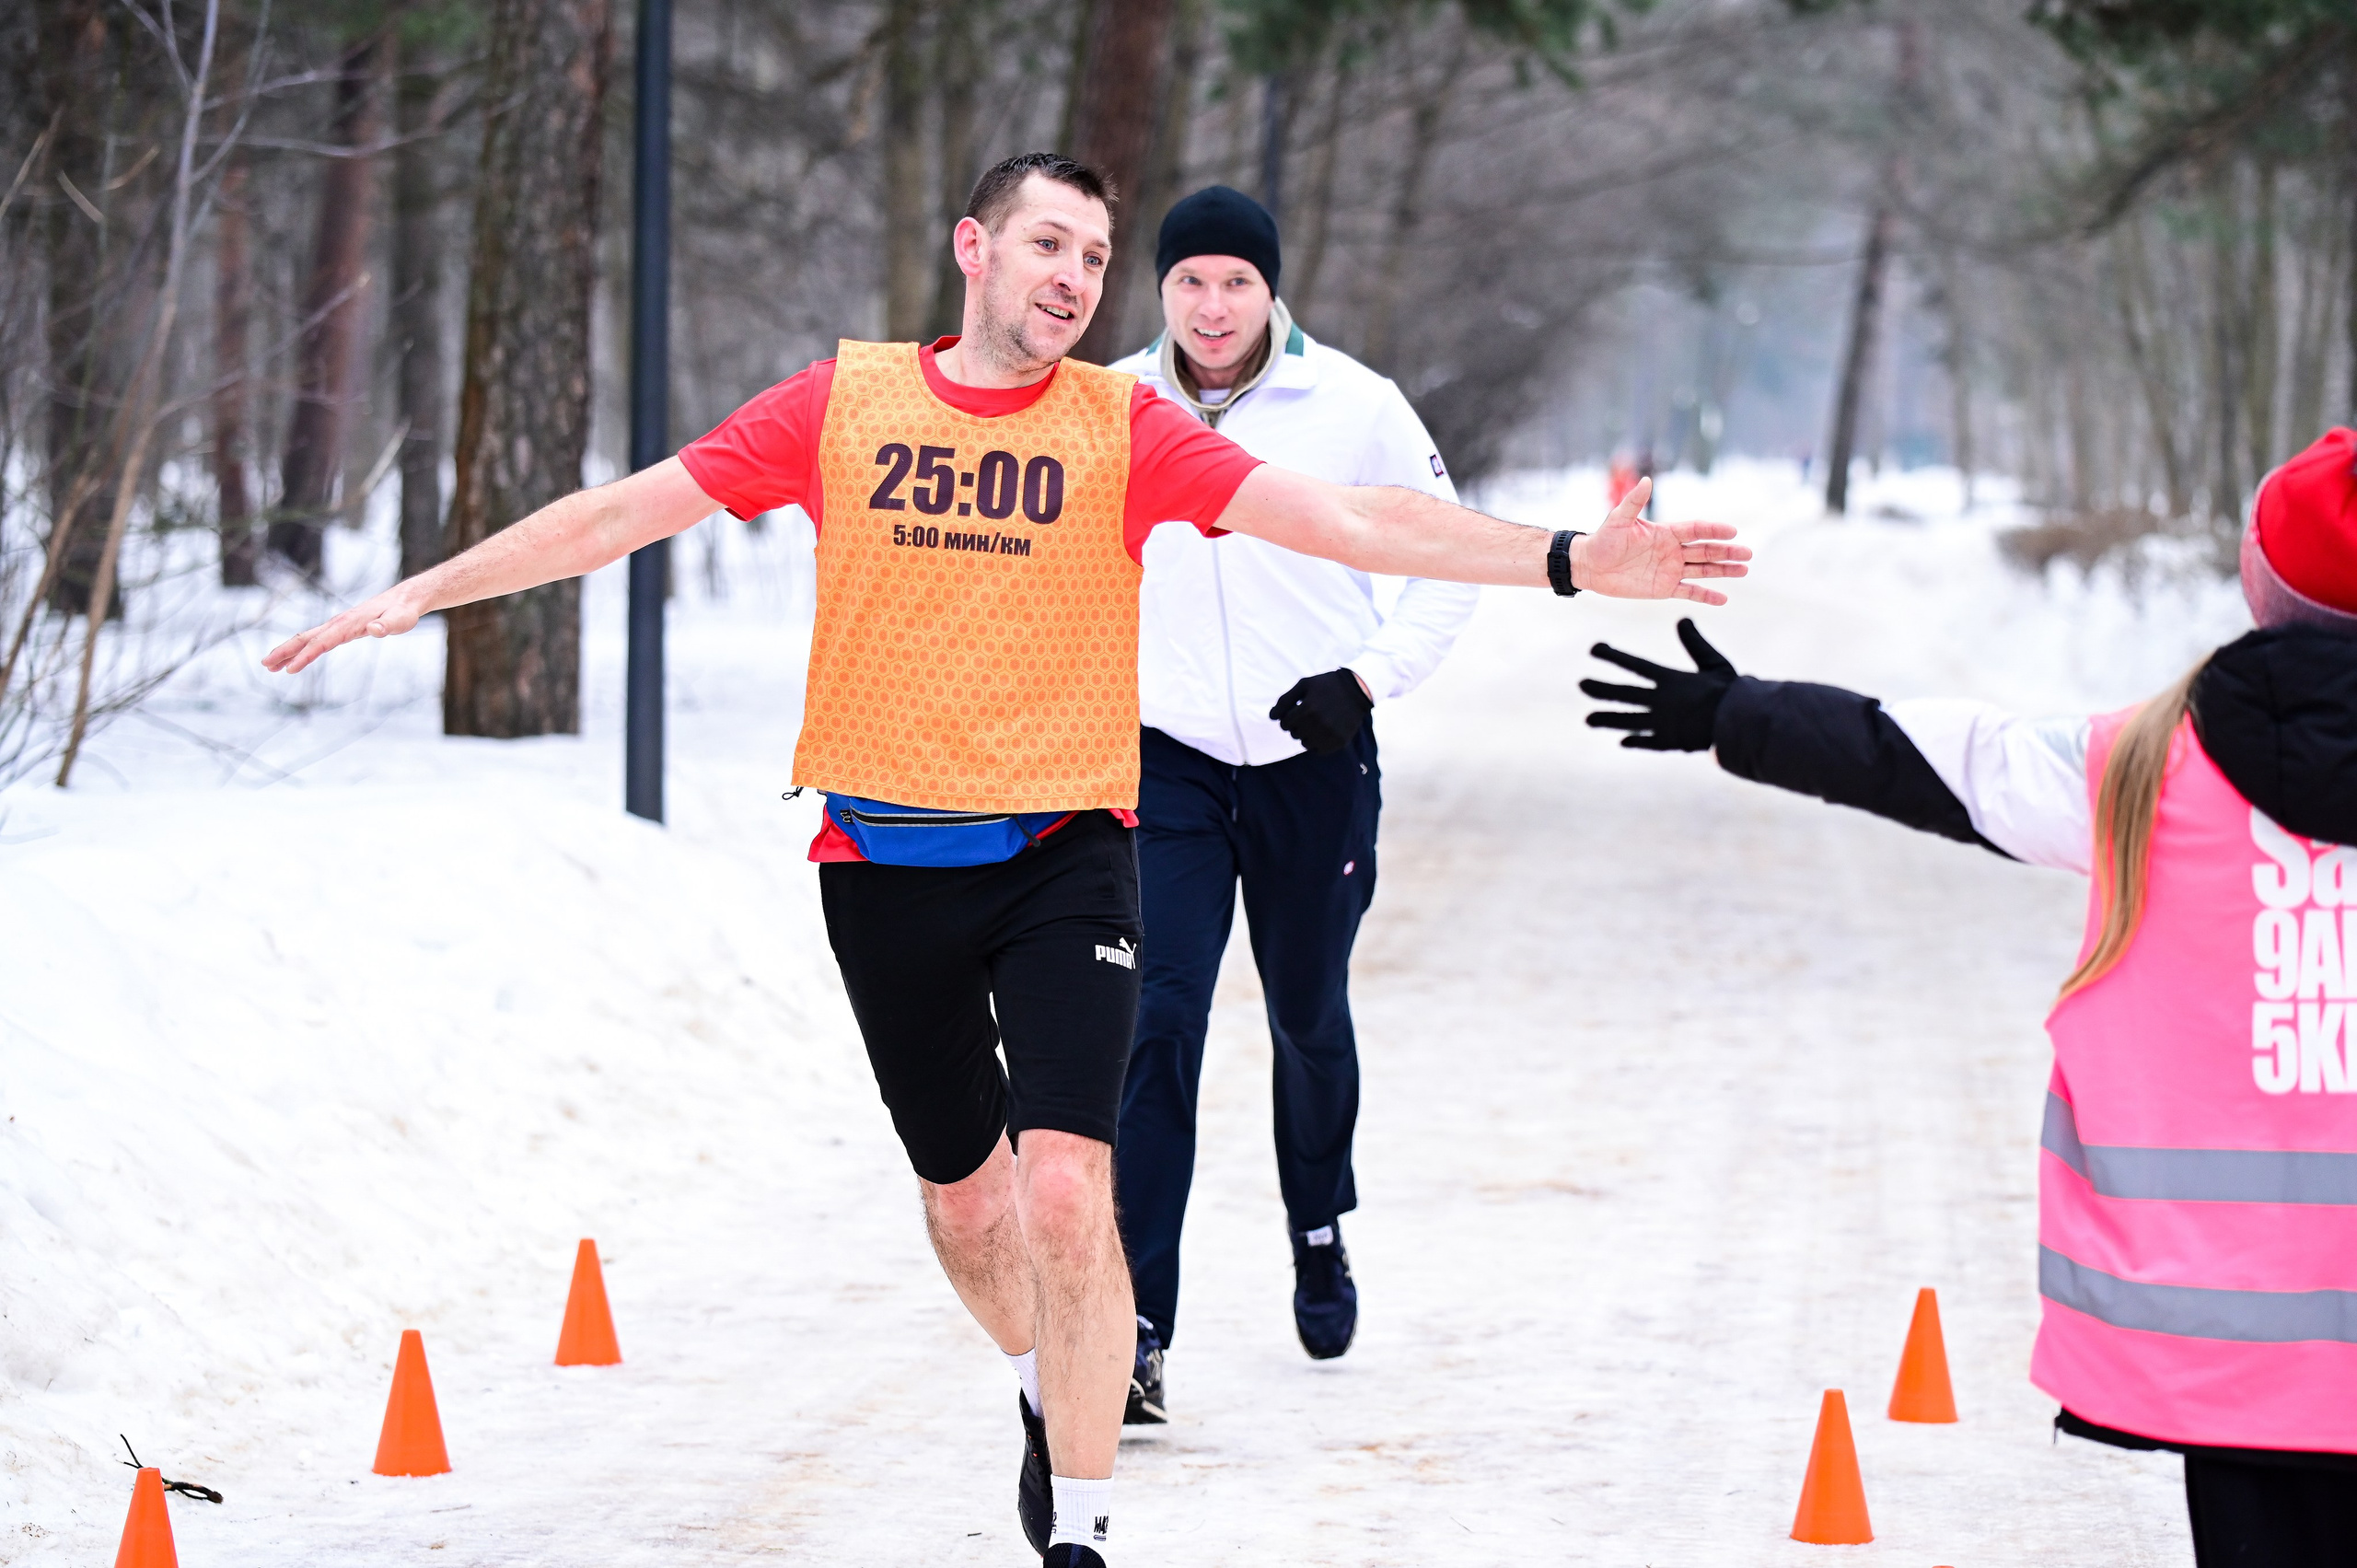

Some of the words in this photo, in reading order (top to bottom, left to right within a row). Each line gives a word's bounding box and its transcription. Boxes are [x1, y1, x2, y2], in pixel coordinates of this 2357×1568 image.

[869, 443, 1064, 524] 25:00
[893, 524, 938, 548] 5:00
[1095, 945, 1132, 970] PUMA
[2252, 909, 2357, 1001] 9A
[2252, 1001, 2357, 1095] 5K
